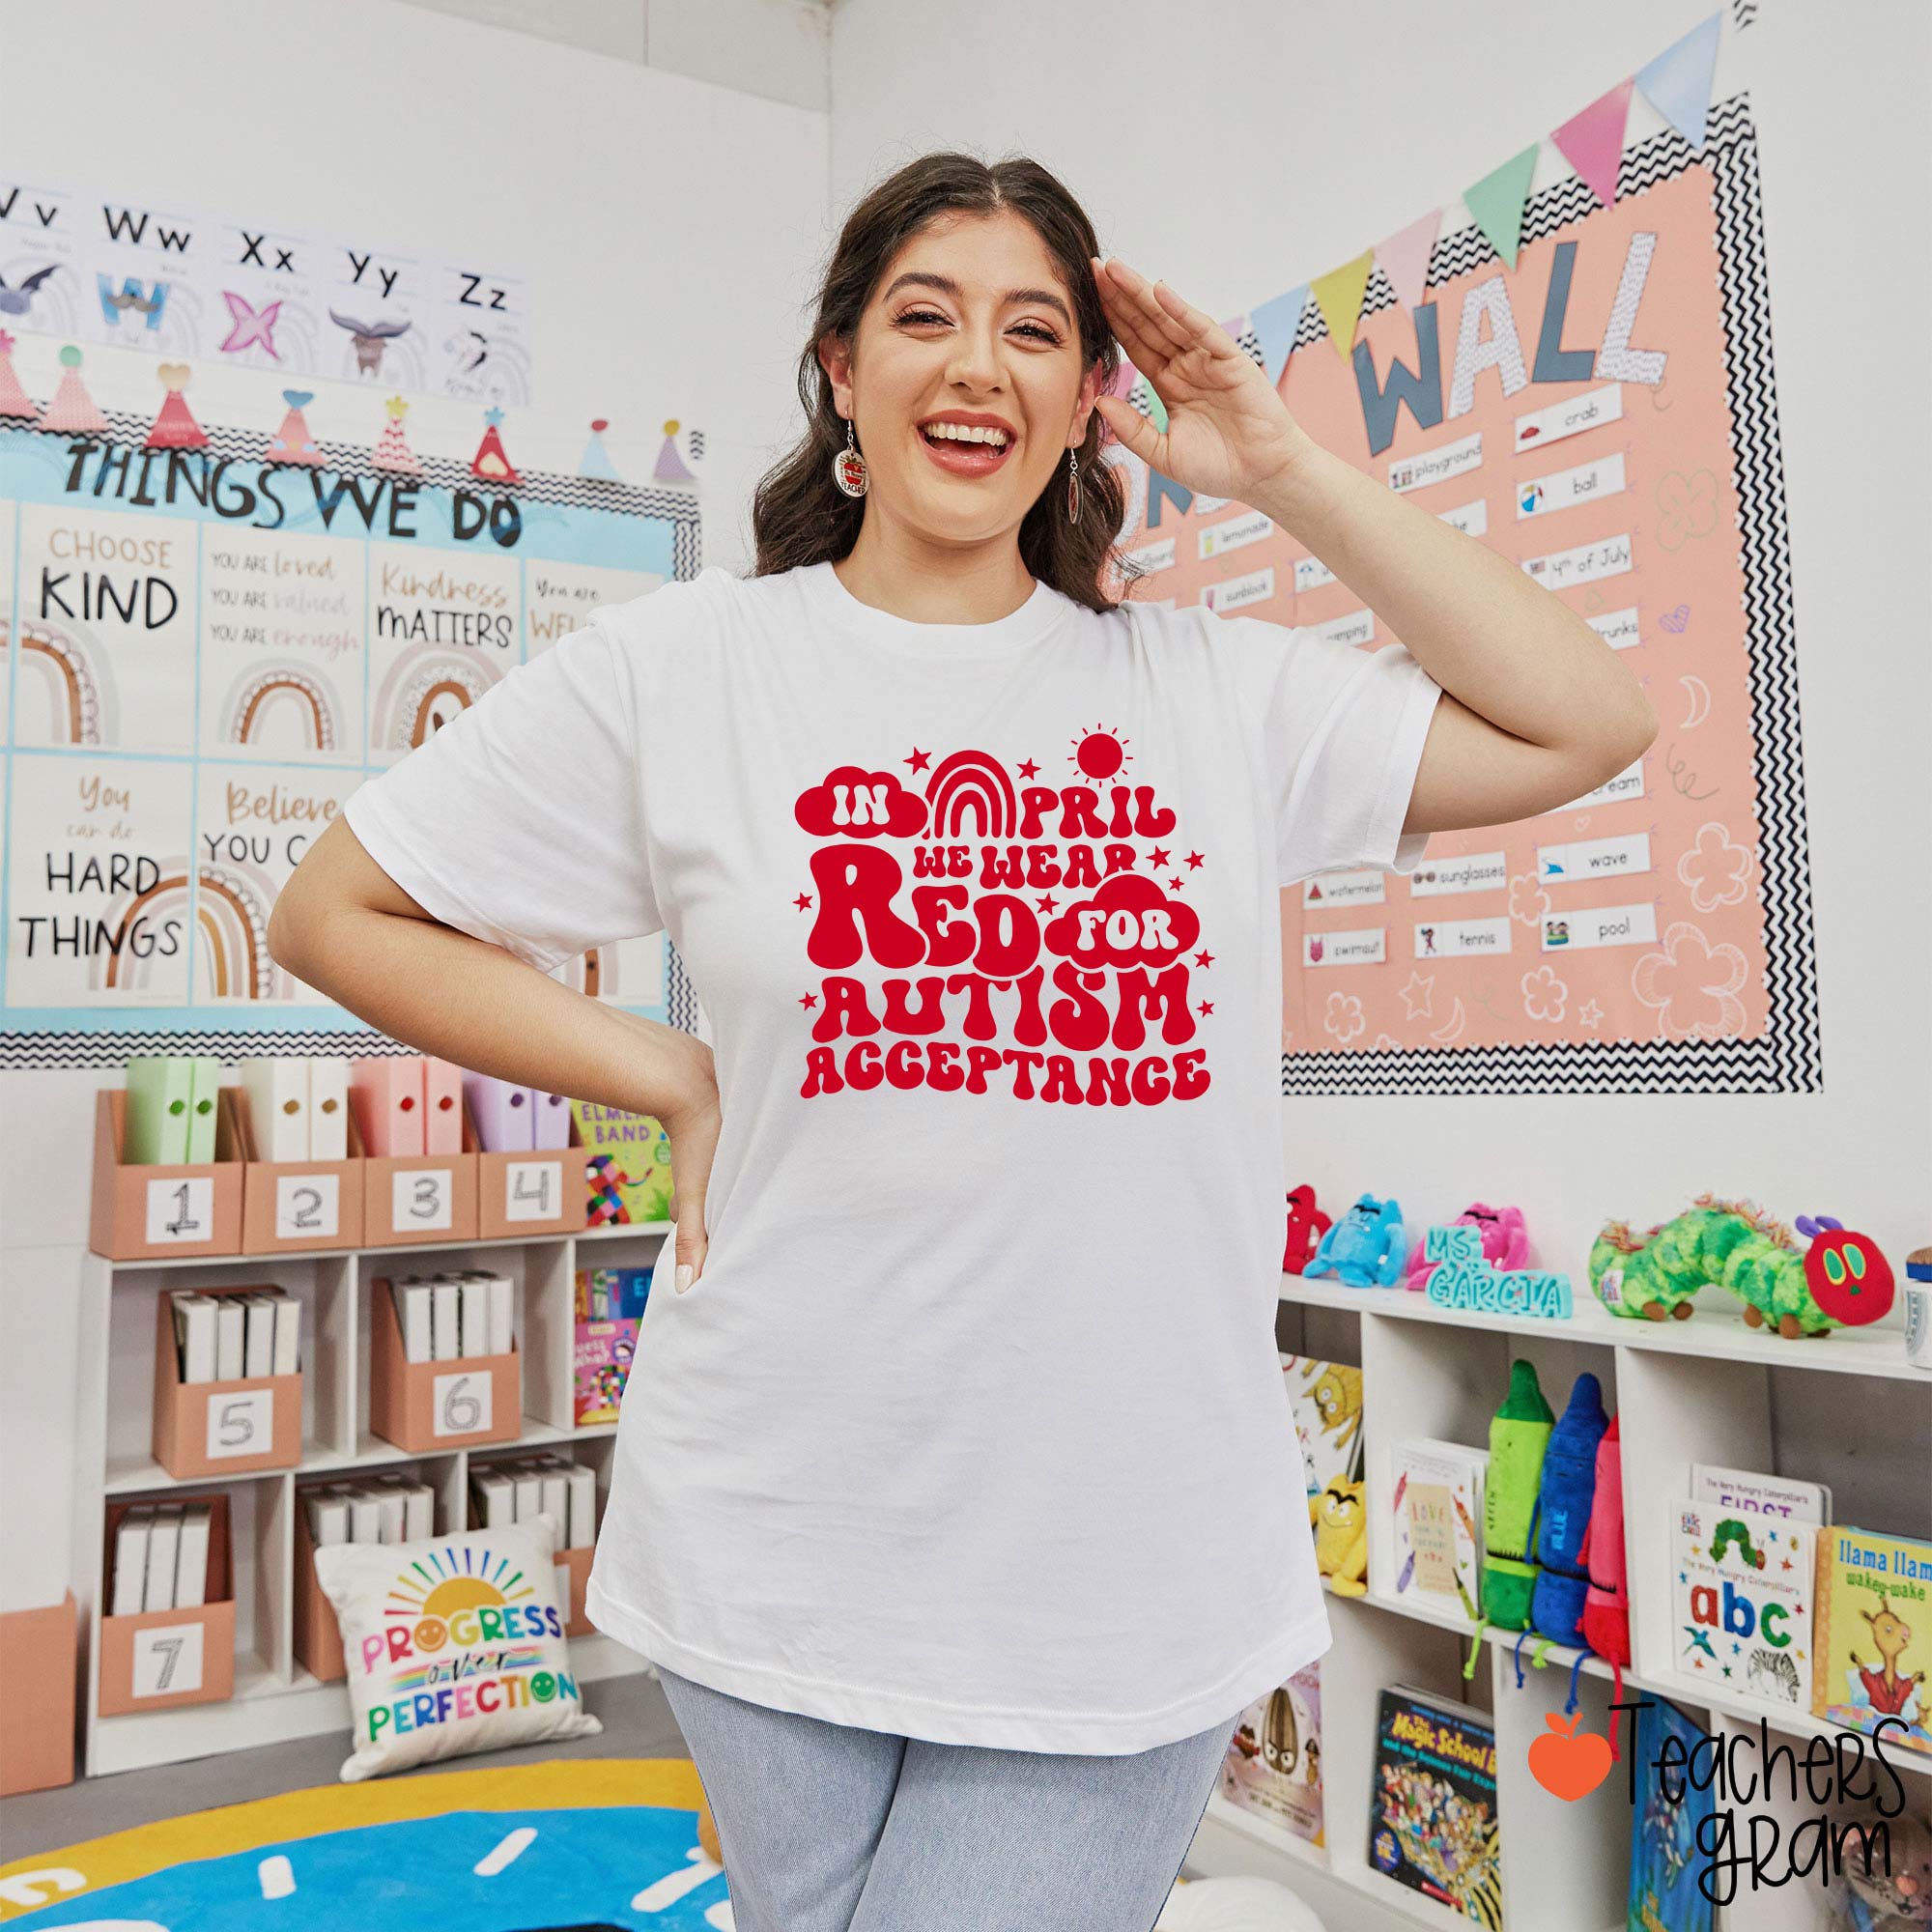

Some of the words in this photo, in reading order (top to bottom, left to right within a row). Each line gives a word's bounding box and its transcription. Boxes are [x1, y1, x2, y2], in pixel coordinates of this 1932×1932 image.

[102, 205, 149, 243] W
[240, 231, 266, 267] X
[459, 272, 483, 306] Z
[1351, 231, 1669, 458] WALL
[1565, 401, 1600, 427] crab
[1415, 437, 1484, 478] playground
[65, 443, 286, 530] THINGS
[309, 467, 420, 538] WE
[453, 489, 522, 548] DO
[1572, 471, 1599, 496] ball
[49, 528, 174, 568] CHOOSE
[1220, 519, 1269, 543] lemonade
[211, 552, 240, 570] YOU
[244, 554, 268, 573] ARE
[273, 550, 335, 581] loved
[1577, 552, 1594, 573] of
[1600, 545, 1631, 566] July
[41, 566, 179, 630] KIND
[211, 587, 240, 607] YOU
[243, 590, 268, 610] ARE
[381, 560, 508, 610] Kindness
[211, 623, 240, 642] YOU
[243, 627, 267, 644] ARE
[78, 774, 131, 812] You
[225, 781, 338, 826] Believe
[833, 783, 891, 826] IN
[203, 834, 270, 866] YOU
[913, 845, 974, 878] WE
[979, 843, 1137, 891] WEAR
[1588, 852, 1629, 868] wave
[45, 851, 160, 896] HARD
[1329, 880, 1384, 898] watermelon
[1438, 865, 1506, 886] sunglasses
[807, 843, 1042, 978] RED
[1076, 908, 1179, 951] FOR
[1599, 915, 1631, 941] pool
[17, 915, 183, 959] THINGS
[1458, 931, 1497, 948] tennis
[810, 961, 1197, 1052] AUTISM
[799, 1039, 1212, 1107] ACCEPTANCE
[595, 1124, 651, 1144] BAND
[165, 1182, 199, 1236] 1
[292, 1188, 323, 1229] 2
[409, 1178, 440, 1218] 3
[513, 1169, 550, 1211] 4
[1429, 1266, 1563, 1317] GARCIA
[218, 1402, 254, 1446] 5
[442, 1377, 481, 1432] 6
[1839, 1538, 1888, 1572] llama
[1690, 1580, 1793, 1648] abc
[361, 1605, 562, 1675] PROGRESS
[150, 1636, 185, 1691] 7
[428, 1651, 510, 1686] over
[367, 1670, 579, 1743] PERFECTION
[1436, 1728, 1488, 1770] School
